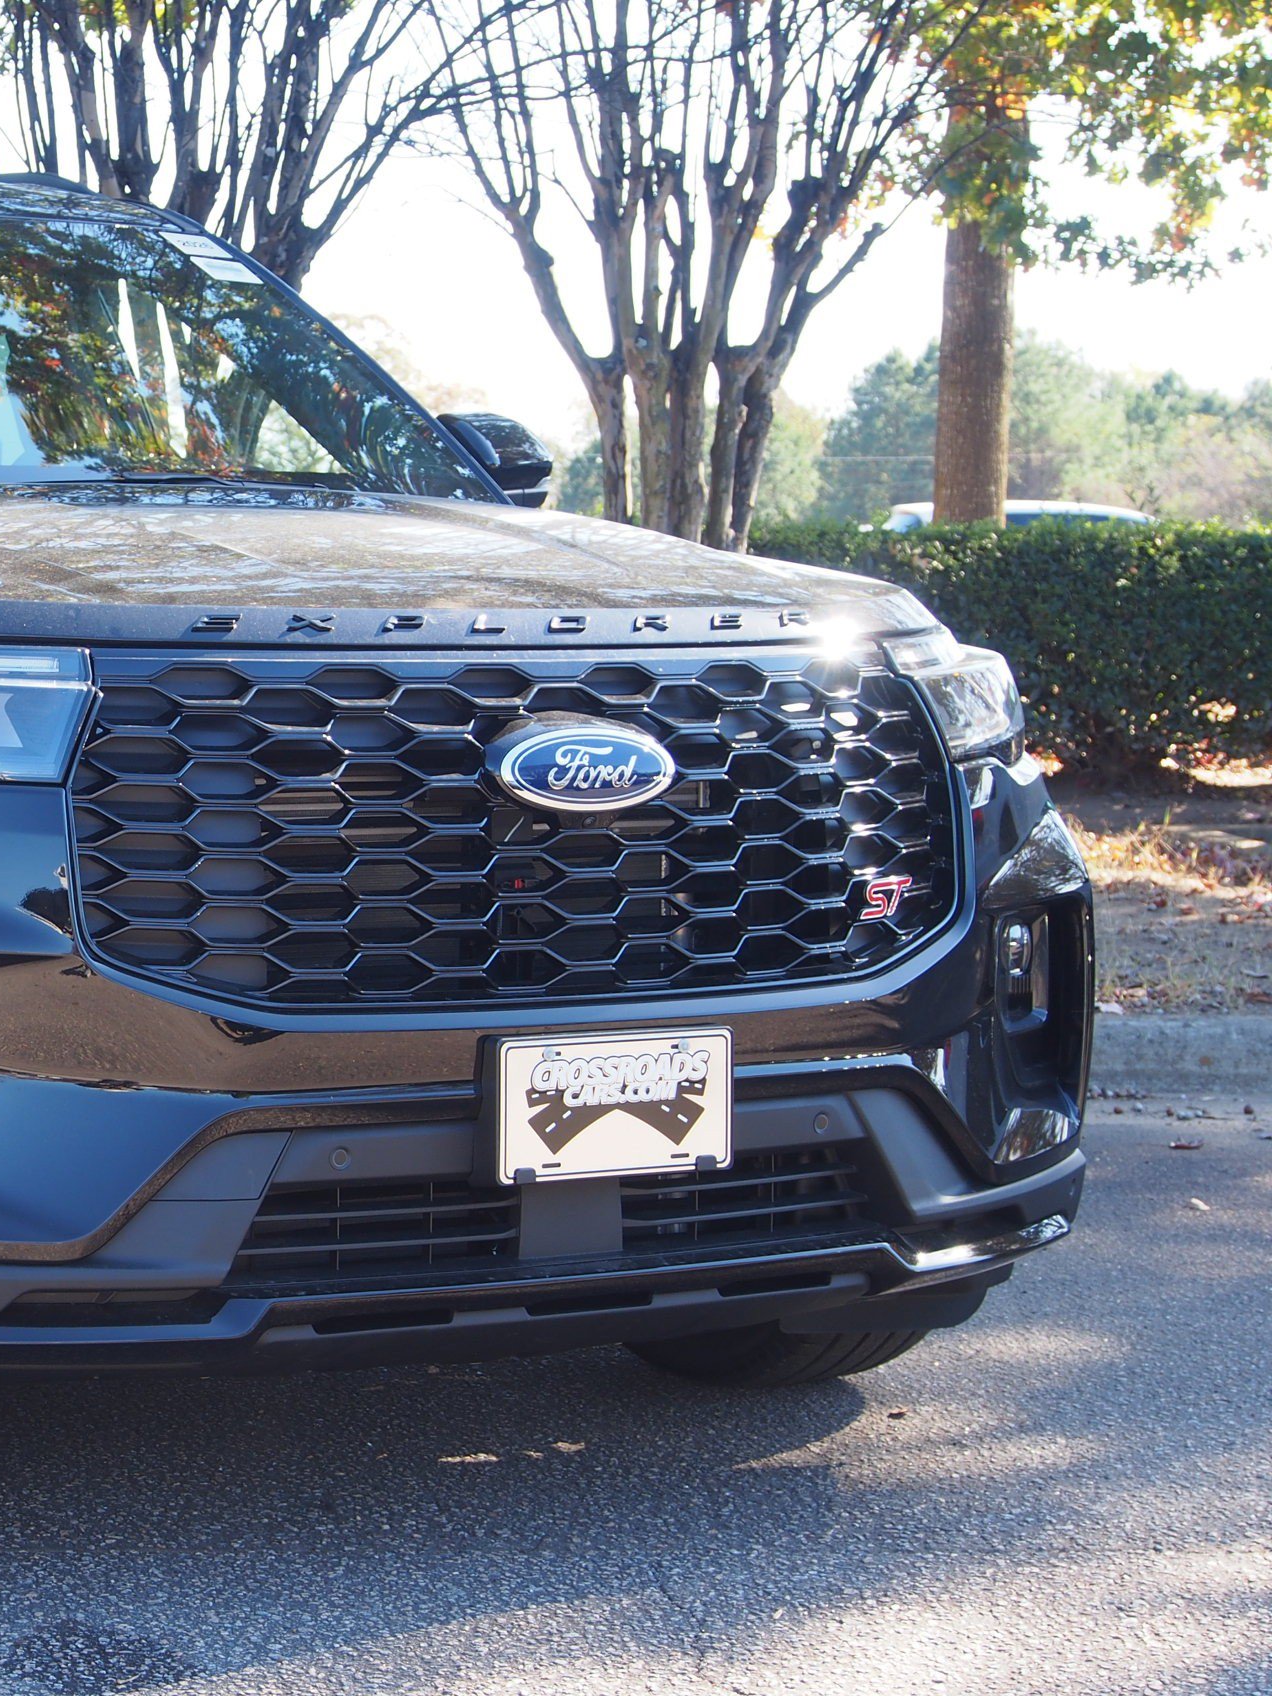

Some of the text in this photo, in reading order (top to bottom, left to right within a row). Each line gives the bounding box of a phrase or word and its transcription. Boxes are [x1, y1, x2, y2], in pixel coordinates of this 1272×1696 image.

[191, 609, 811, 634] EXPLORER
[547, 744, 637, 790] Ford
[860, 874, 912, 920] ST
[531, 1050, 710, 1092] CROSSROADS
[563, 1080, 678, 1107] CARS.COM
